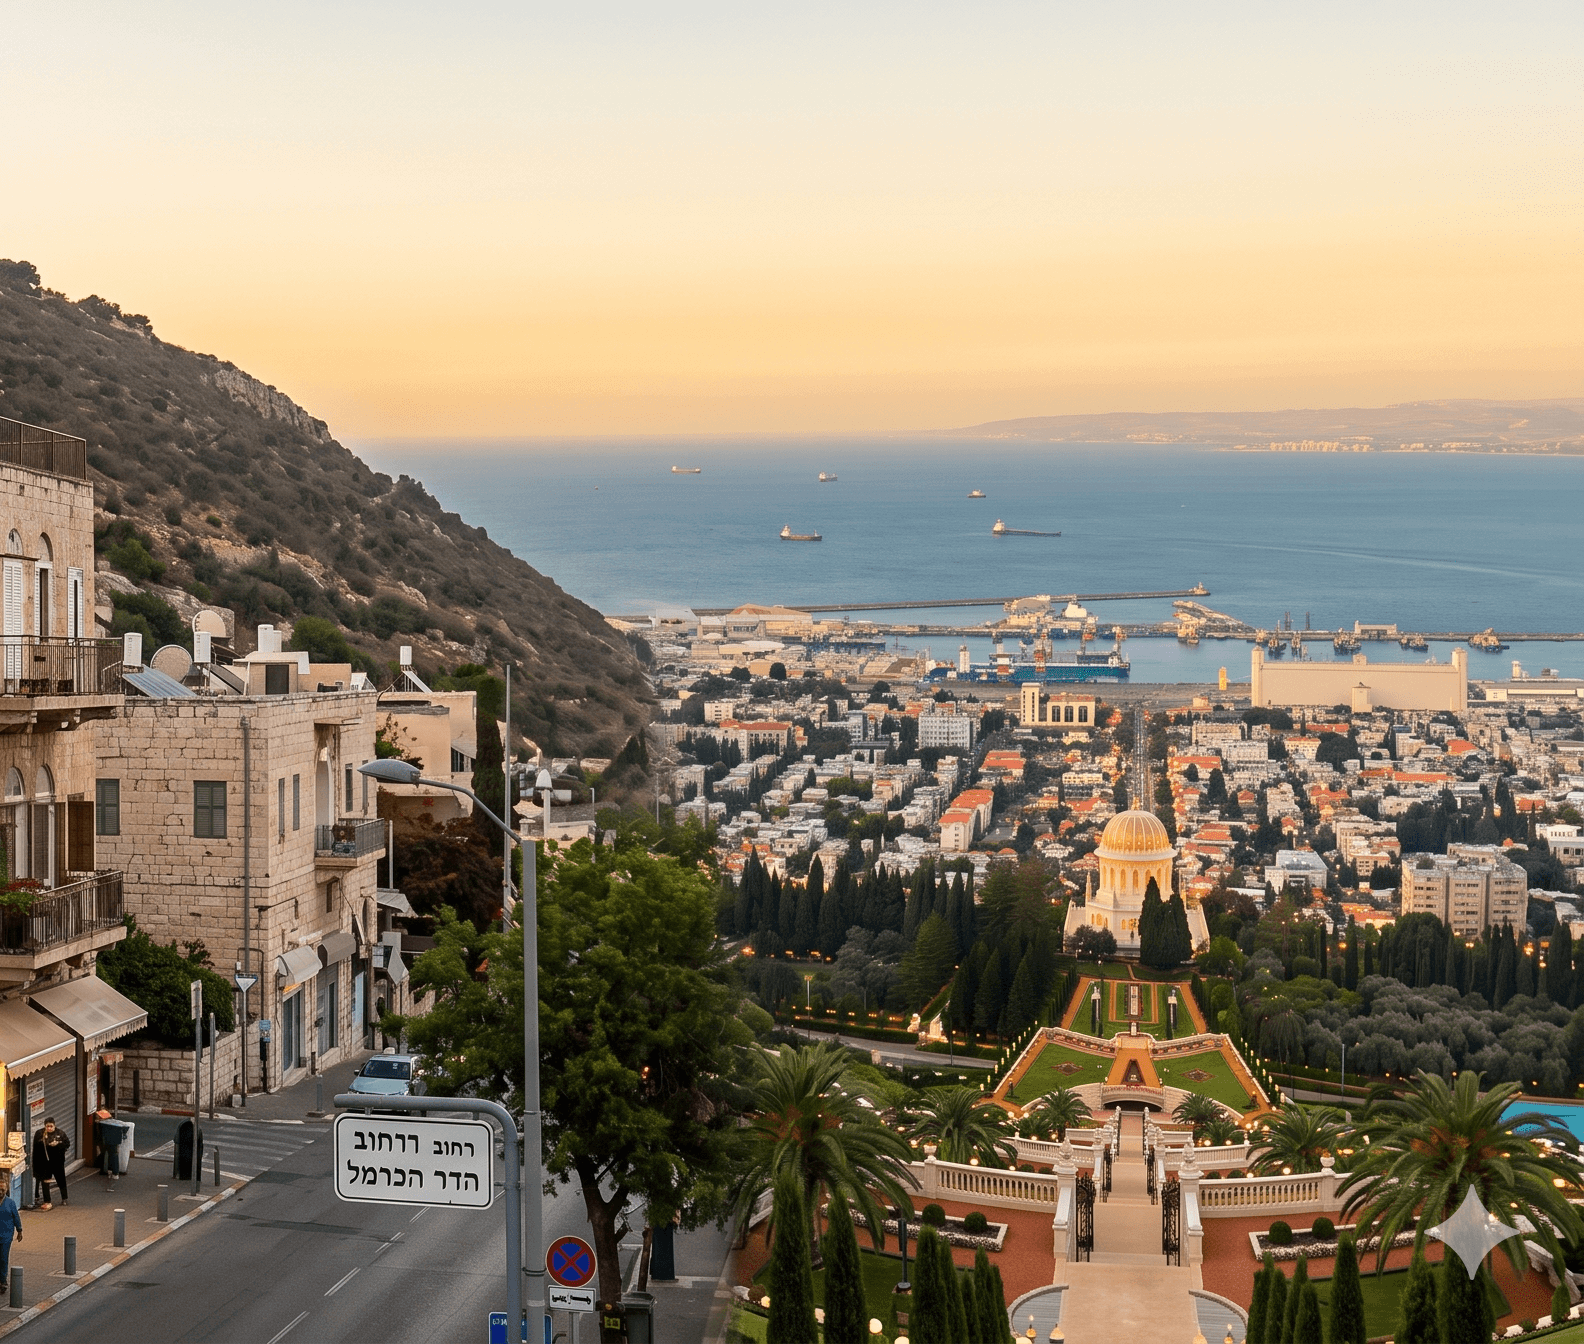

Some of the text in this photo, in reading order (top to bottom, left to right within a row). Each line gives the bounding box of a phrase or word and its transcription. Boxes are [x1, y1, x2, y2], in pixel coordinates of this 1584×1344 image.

[433, 1140, 474, 1157] רחוב
[347, 1159, 479, 1192] הדר הכרמל
